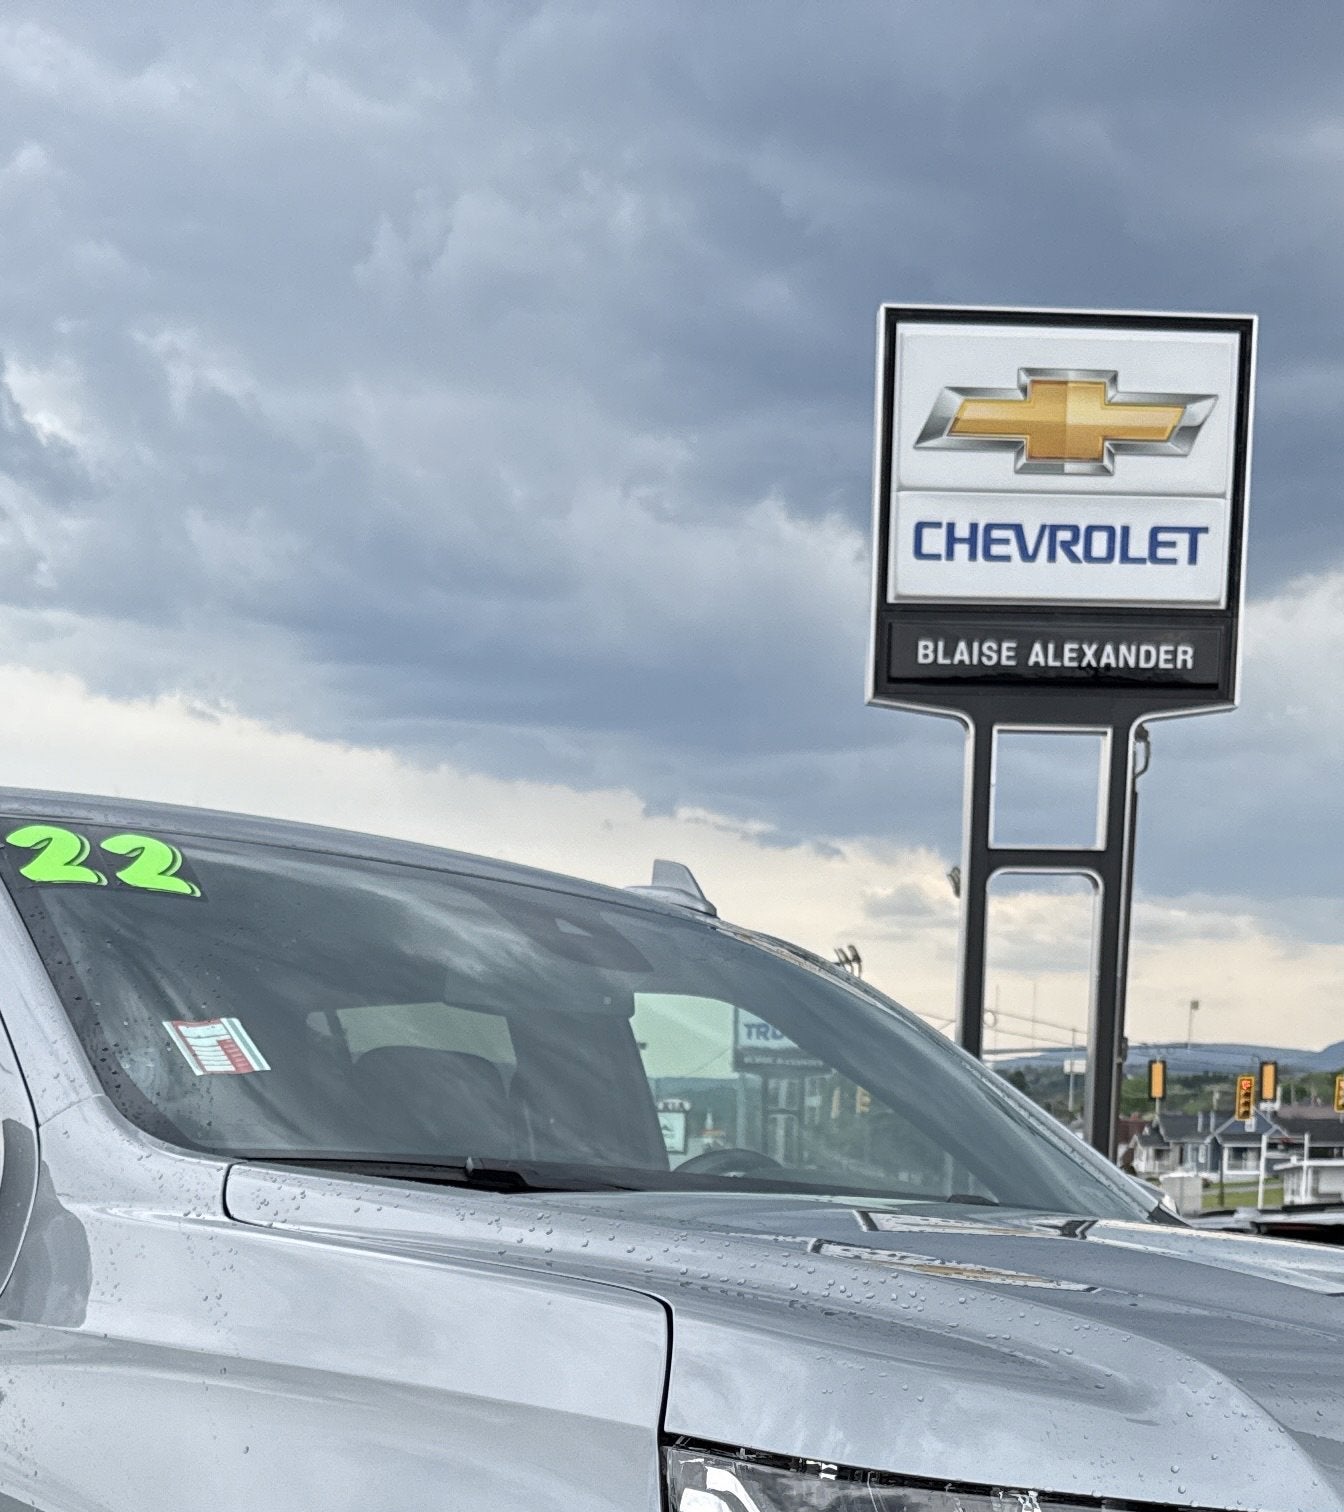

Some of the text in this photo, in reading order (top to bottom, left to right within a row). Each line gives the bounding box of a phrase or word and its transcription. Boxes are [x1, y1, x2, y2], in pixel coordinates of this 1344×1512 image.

[913, 520, 1210, 567] CHEVROLET
[916, 638, 1195, 671] BLAISE ALEXANDER
[5, 825, 202, 898] 22
